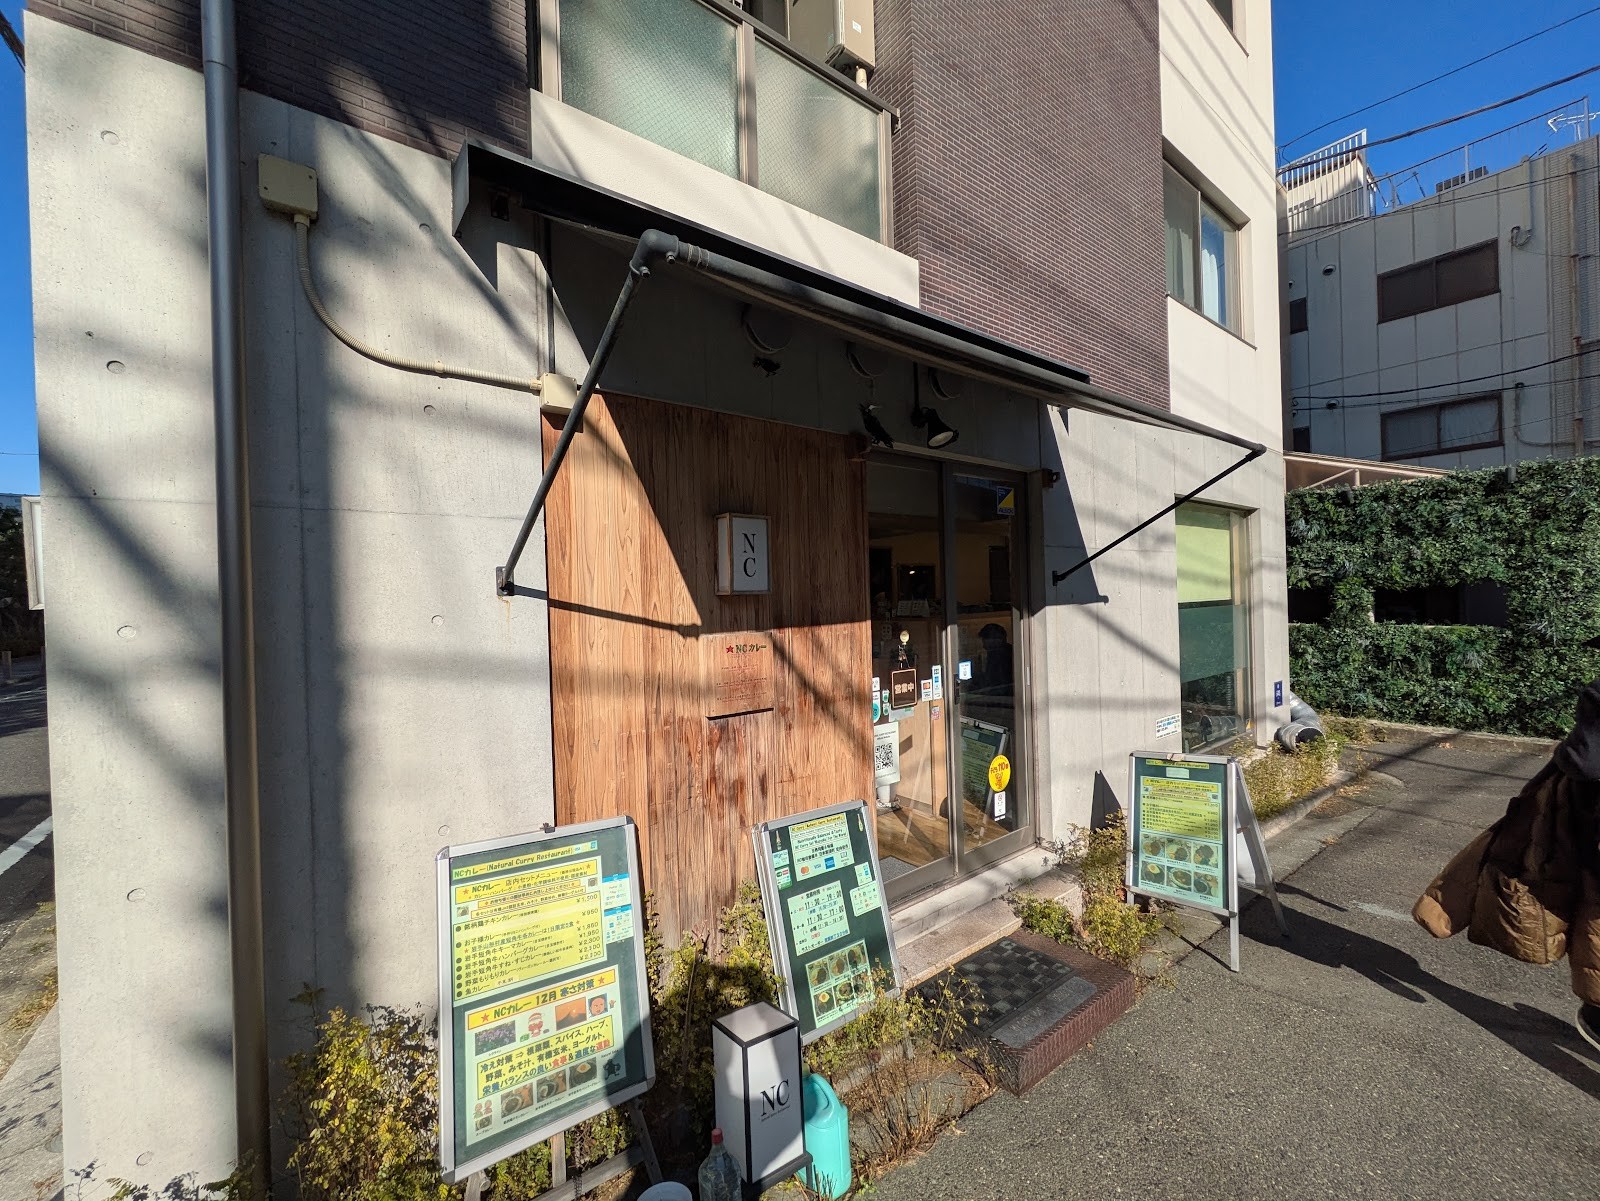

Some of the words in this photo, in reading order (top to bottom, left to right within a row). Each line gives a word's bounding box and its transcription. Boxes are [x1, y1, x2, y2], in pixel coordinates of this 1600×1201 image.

[742, 533, 757, 577] NC
[895, 682, 914, 694] 営業中
[515, 855, 533, 865] Curry
[536, 847, 572, 860] Restaurant)
[471, 883, 500, 892] NCカレー
[493, 1000, 531, 1019] NCカレー
[535, 989, 557, 1006] 12月
[559, 977, 594, 998] 寒さ対策
[480, 1053, 513, 1073] 冷え対策
[760, 1079, 790, 1117] NC
